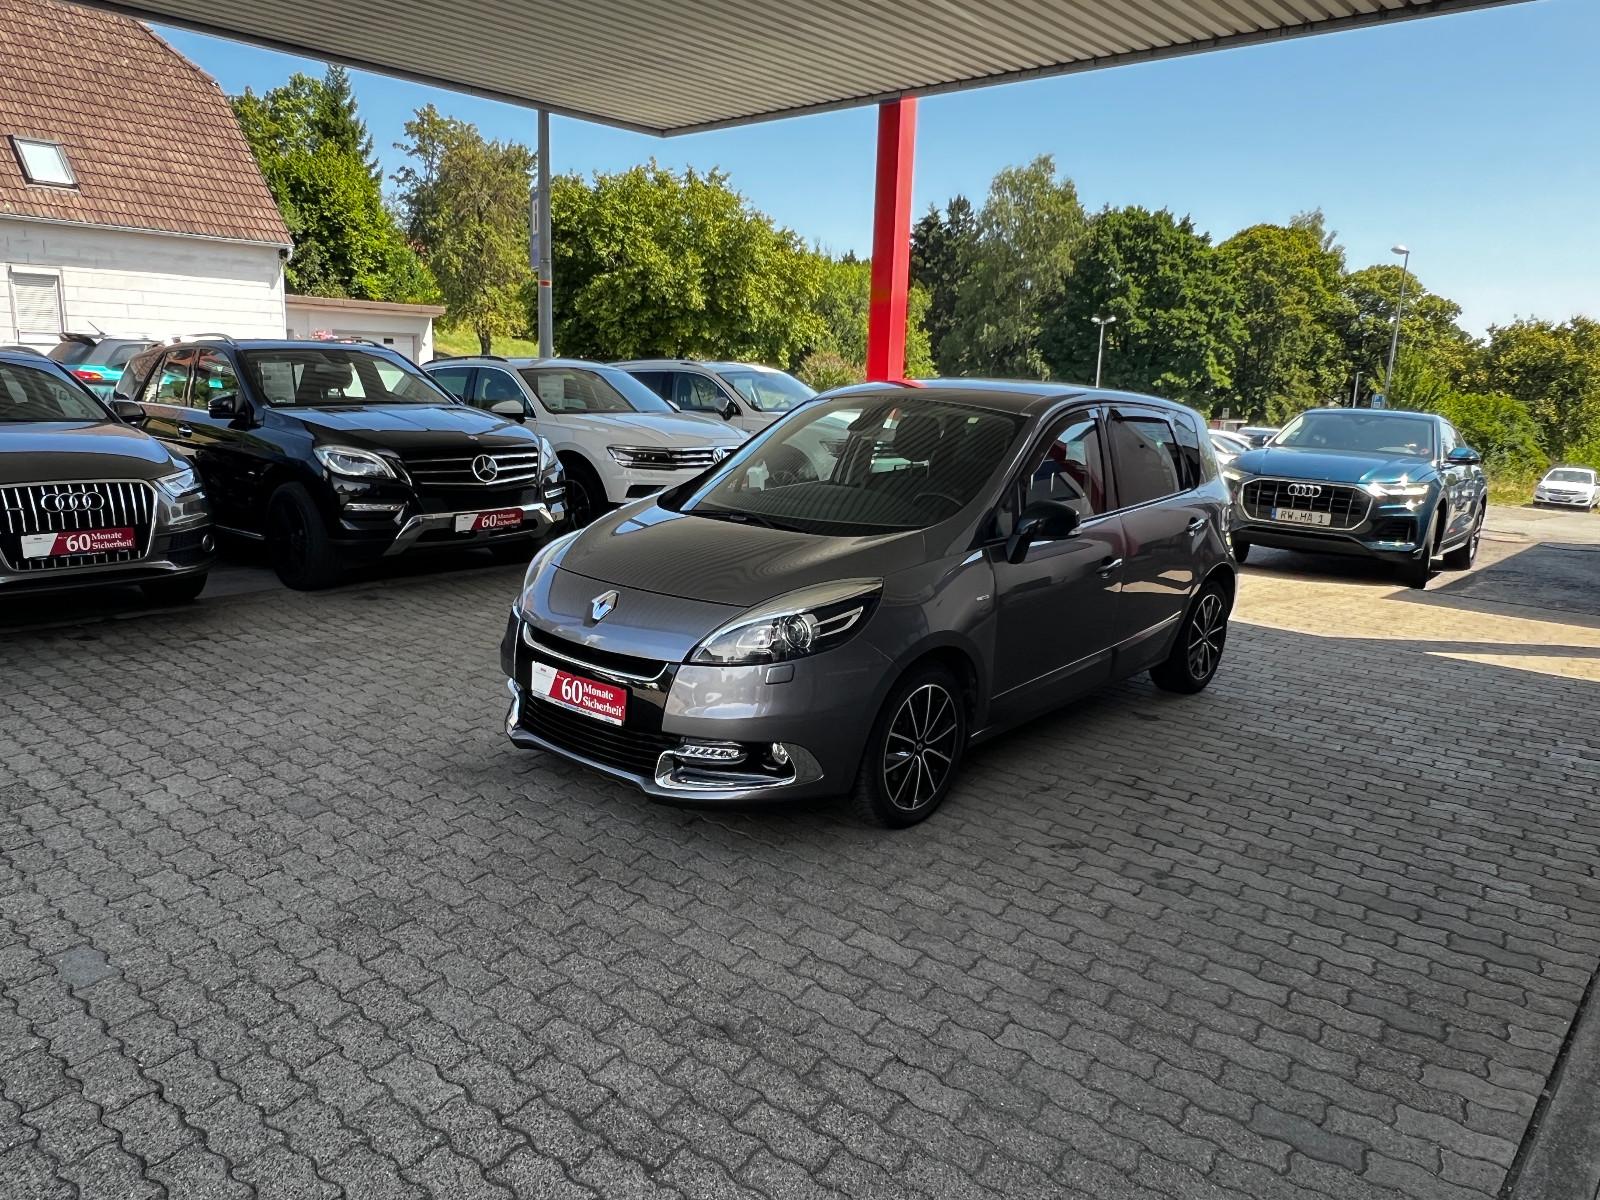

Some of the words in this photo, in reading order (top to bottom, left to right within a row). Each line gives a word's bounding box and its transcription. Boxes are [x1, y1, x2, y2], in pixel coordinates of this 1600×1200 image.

[482, 515, 496, 527] 60
[66, 533, 91, 552] 60
[91, 532, 122, 540] Monate
[561, 678, 582, 704] 60
[583, 682, 613, 700] Monate
